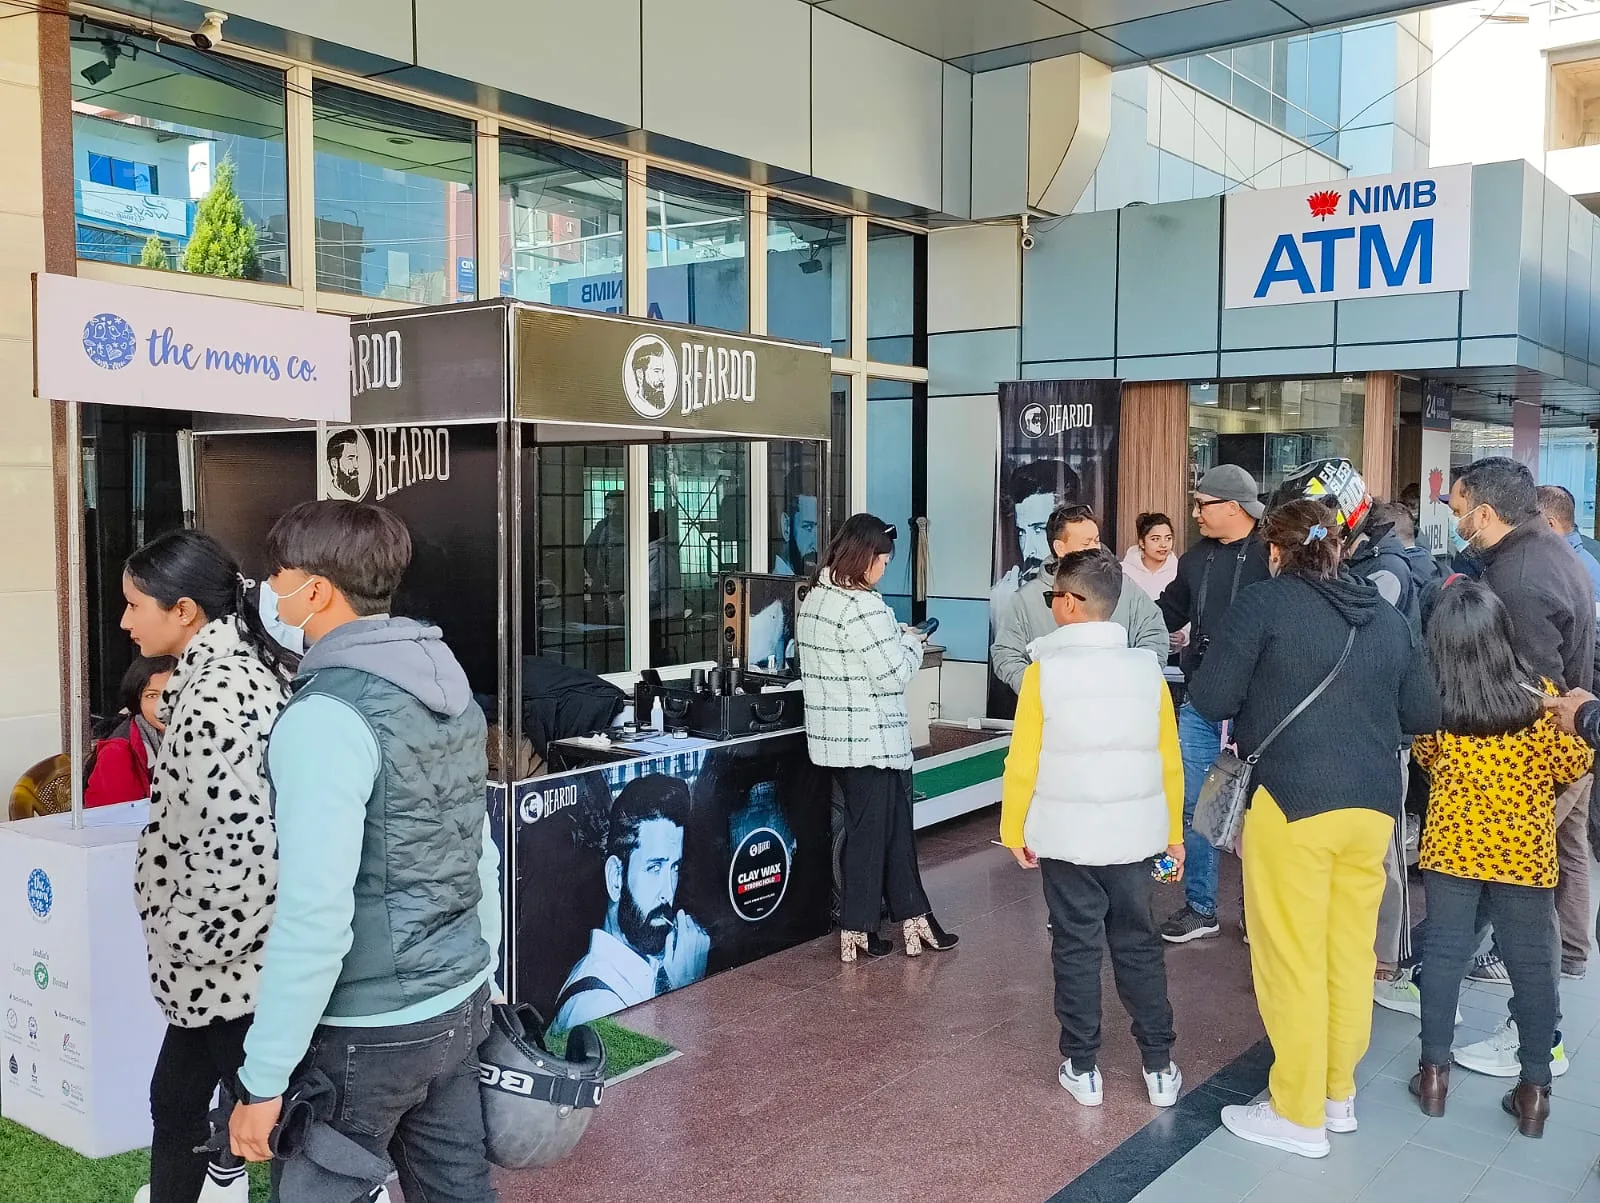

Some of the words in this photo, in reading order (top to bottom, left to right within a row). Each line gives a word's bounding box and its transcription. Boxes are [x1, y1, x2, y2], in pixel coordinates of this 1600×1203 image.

[1348, 179, 1437, 216] NIMB
[1253, 218, 1434, 299] ATM
[145, 326, 201, 371] the
[205, 347, 281, 381] moms
[287, 355, 318, 382] co.
[349, 330, 402, 397] ARDO
[681, 342, 757, 417] BEARDO
[1048, 403, 1093, 437] BEARDO
[1425, 394, 1437, 419] 24
[375, 427, 450, 502] BEARDO
[1319, 462, 1338, 485] EAT
[543, 784, 578, 819] BEARDO
[737, 868, 760, 884] CLAY
[760, 862, 781, 878] WAX
